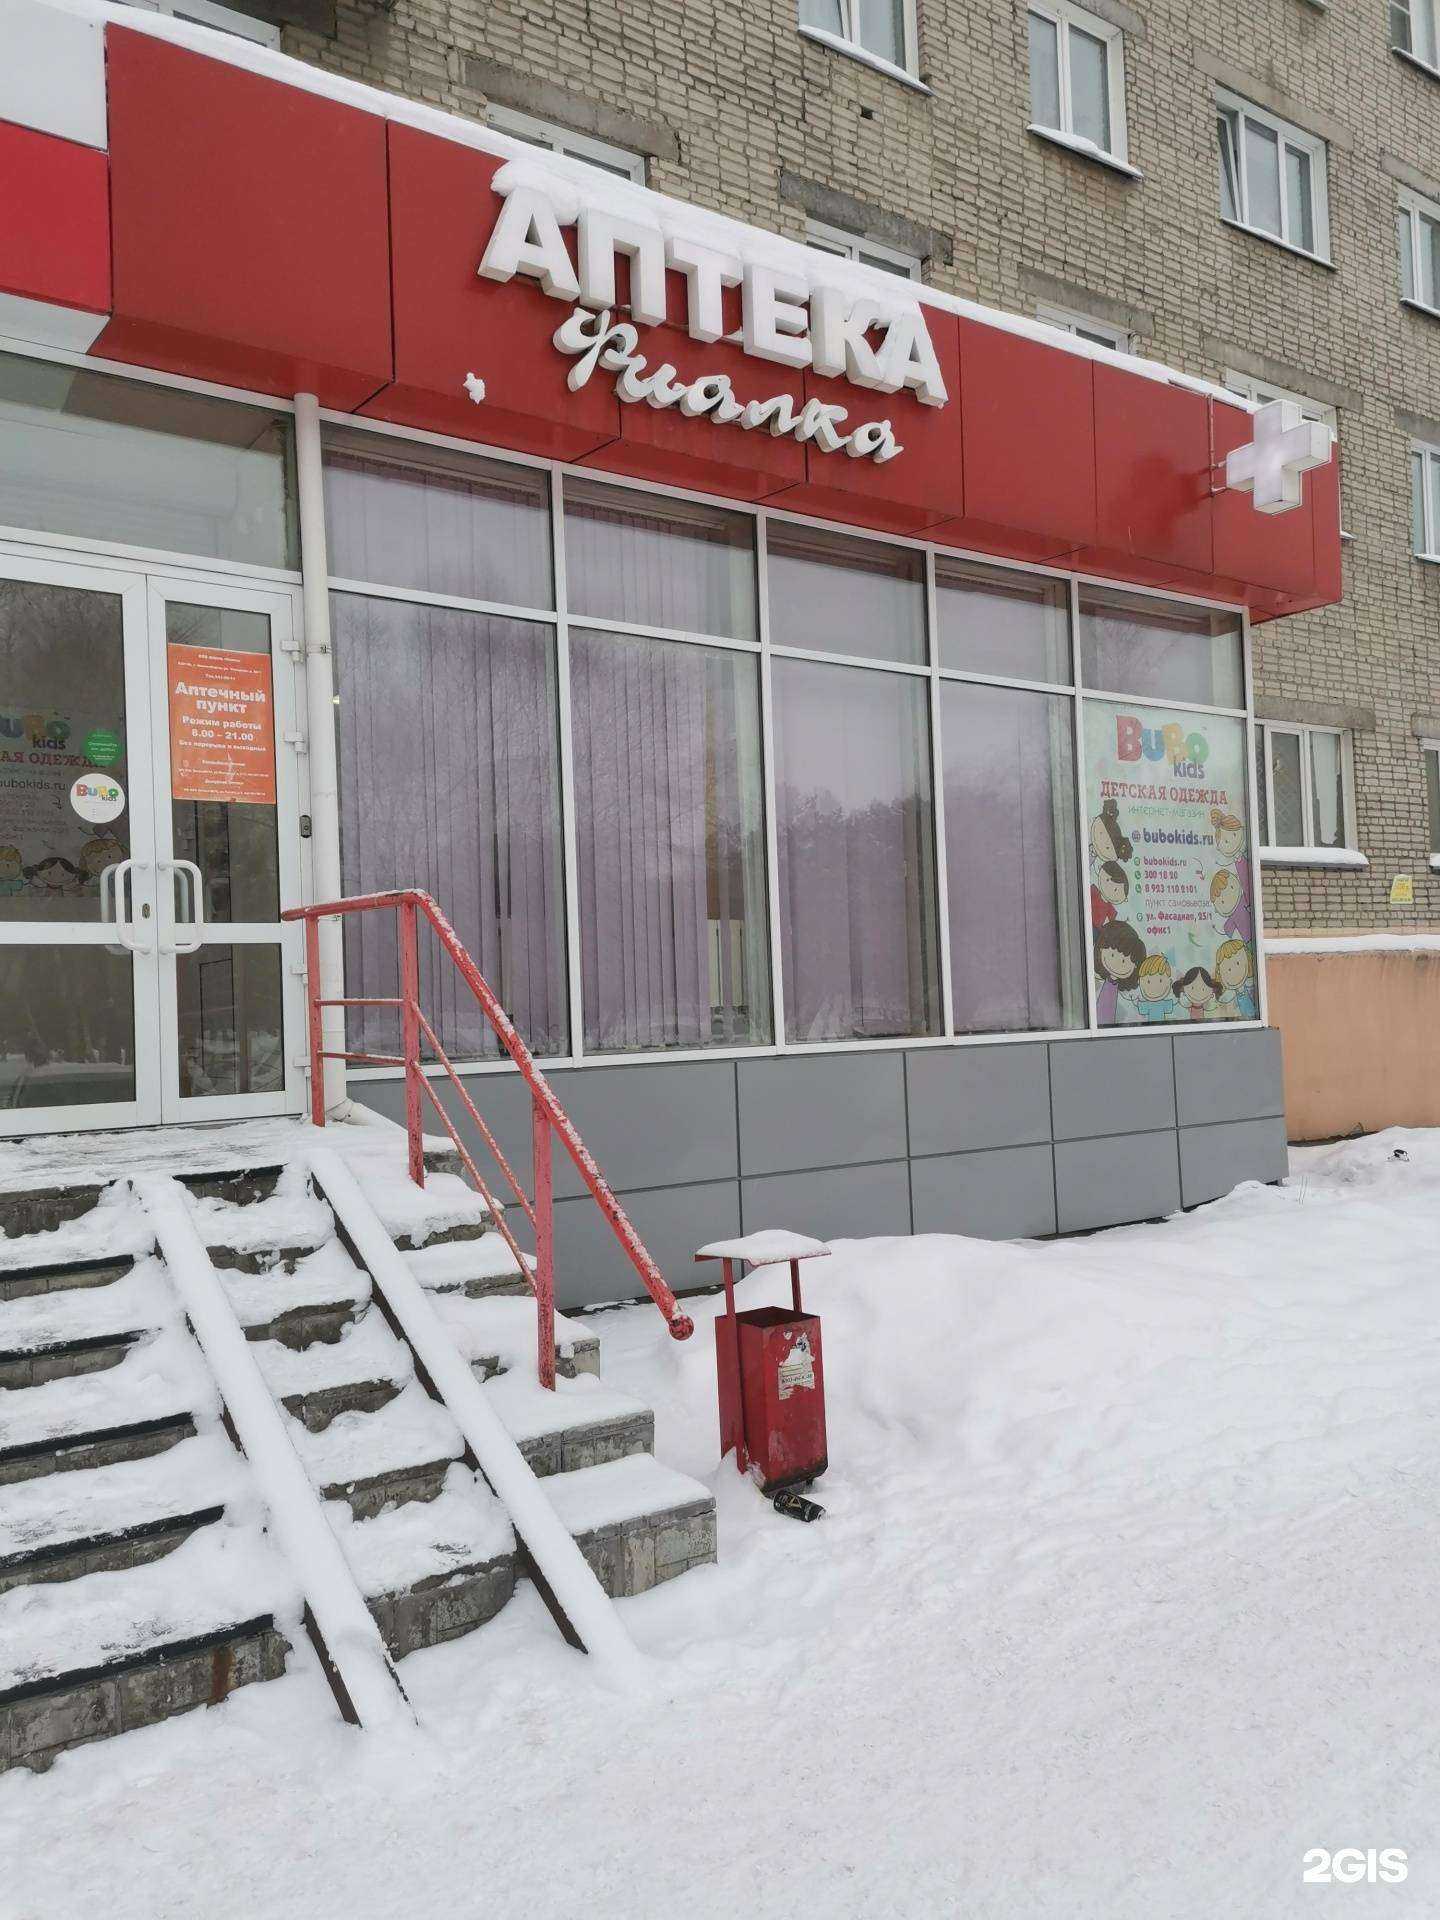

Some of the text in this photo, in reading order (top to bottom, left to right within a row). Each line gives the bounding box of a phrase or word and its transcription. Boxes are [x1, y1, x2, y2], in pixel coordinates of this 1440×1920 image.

[478, 186, 949, 408] АПТЕКА
[175, 681, 266, 702] Аптечный
[196, 699, 247, 714] пункт
[182, 715, 262, 730] Режим работы
[191, 728, 214, 738] 8.00
[225, 731, 254, 741] 21.00
[1173, 756, 1205, 780] kids
[1100, 780, 1228, 806] ДЕТСКАЯ ОДЕЖДА
[1143, 827, 1214, 846] bubokids.ru
[1143, 855, 1188, 867] bubokids.ru
[1151, 883, 1165, 894] 923
